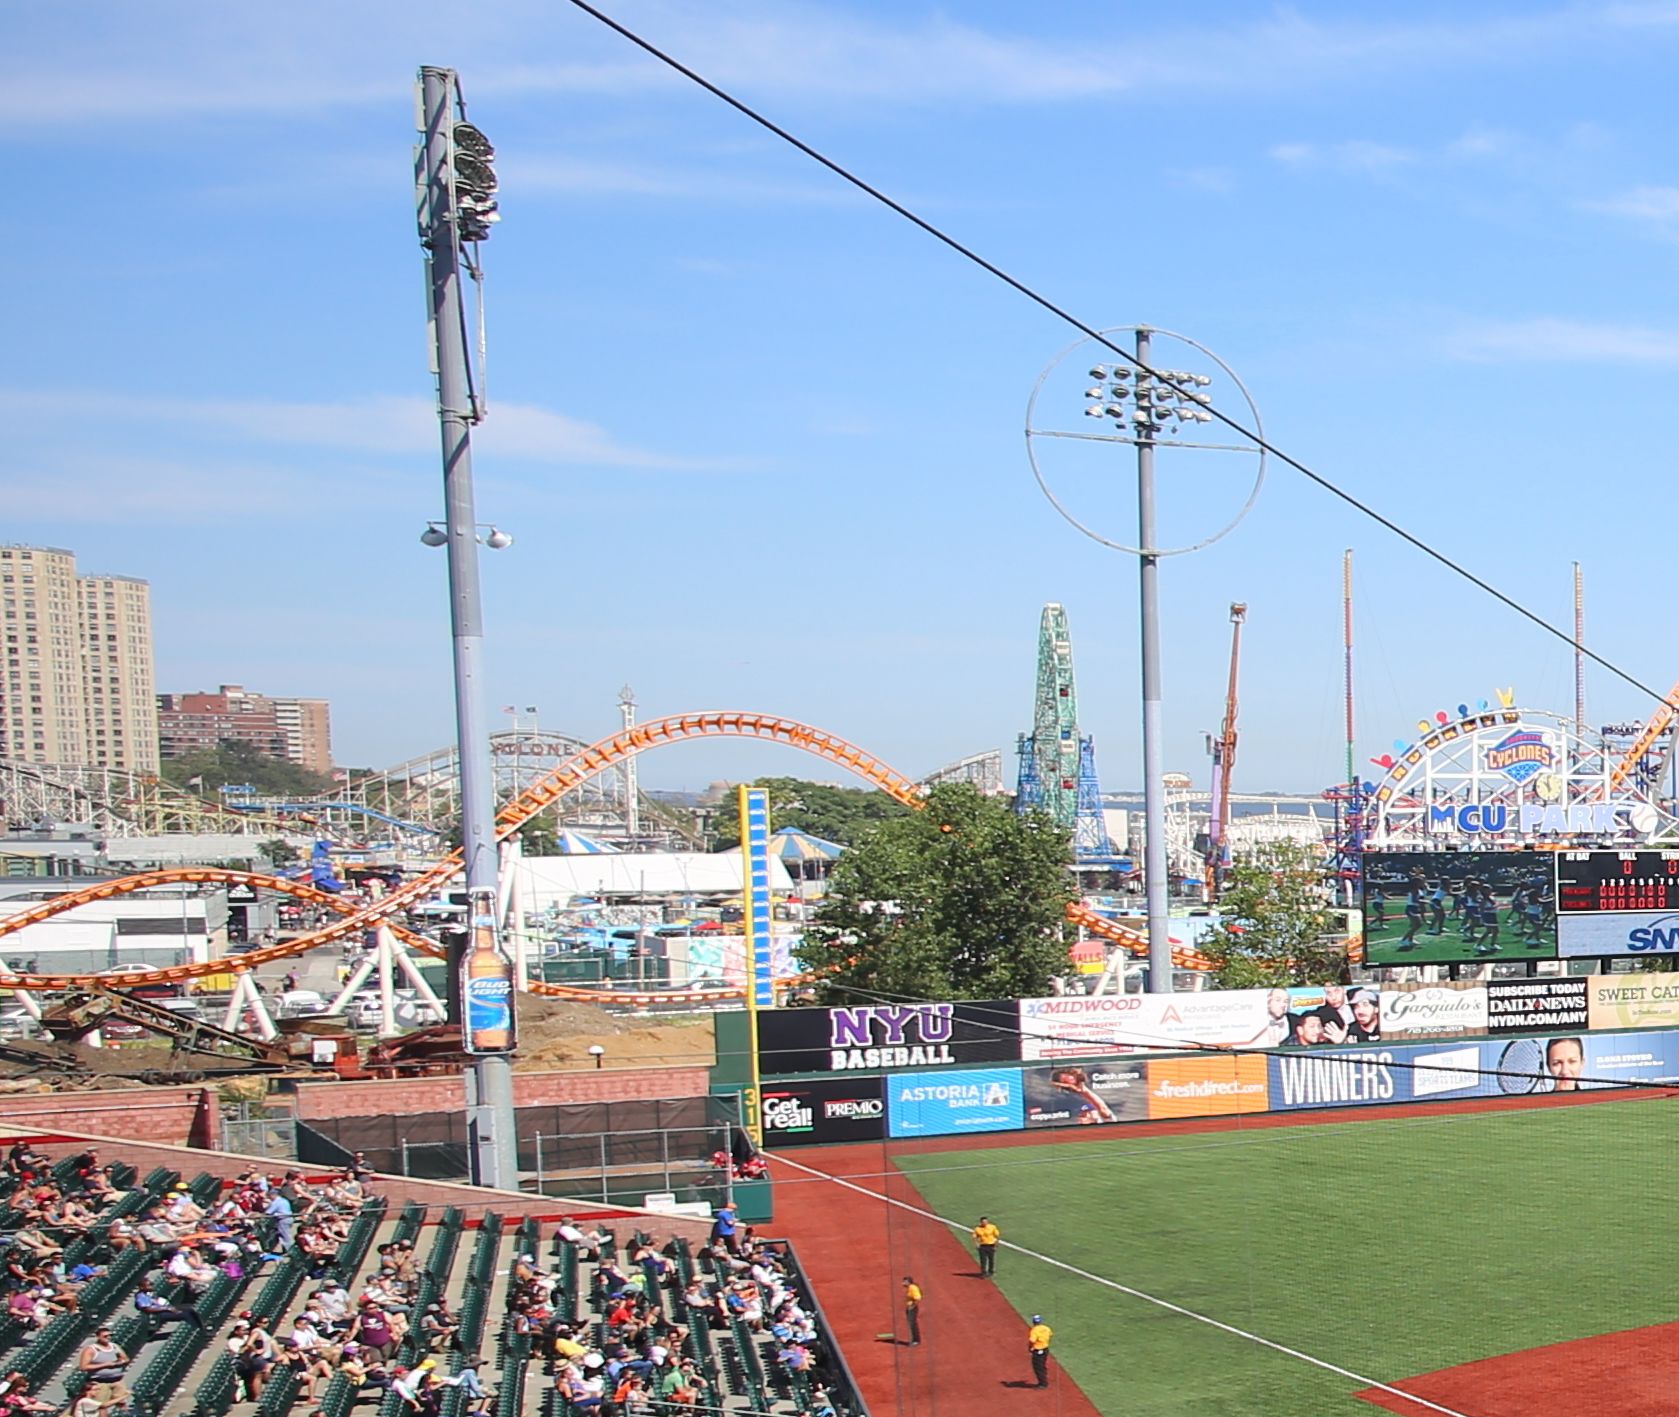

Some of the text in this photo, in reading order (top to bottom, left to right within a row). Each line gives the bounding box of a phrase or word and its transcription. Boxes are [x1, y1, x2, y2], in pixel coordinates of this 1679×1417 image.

[1488, 747, 1551, 770] CYCLONES
[1430, 804, 1618, 834] MCU PARK
[1618, 852, 1637, 861] BALL
[1624, 860, 1632, 875] 0
[1601, 878, 1606, 886] 1
[1630, 878, 1636, 886] 4
[1659, 878, 1665, 886] 7
[469, 987, 512, 995] LIGHT
[473, 980, 511, 989] BUD
[1489, 982, 1585, 998] SUBSCRIBE TODAY
[1598, 987, 1647, 1002] SWEET
[1044, 999, 1141, 1013] MIDWOOD
[1184, 1003, 1253, 1013] AdvantageCare
[1383, 993, 1483, 1021] Gargiulo's
[1490, 996, 1586, 1013] DAILY NEWS
[830, 1003, 954, 1048] NYU
[1489, 1012, 1587, 1027] NYDN.COM/ANY
[831, 1045, 955, 1070] BASEBALL
[1092, 1071, 1140, 1082] Catch more
[1280, 1052, 1393, 1104] WINNERS
[901, 1084, 979, 1102] ASTORIA
[1157, 1079, 1264, 1099] freshdirect.com
[763, 1097, 801, 1115] Get
[827, 1100, 883, 1117] PREMIO
[949, 1098, 980, 1108] BANK
[764, 1107, 813, 1129] real!
